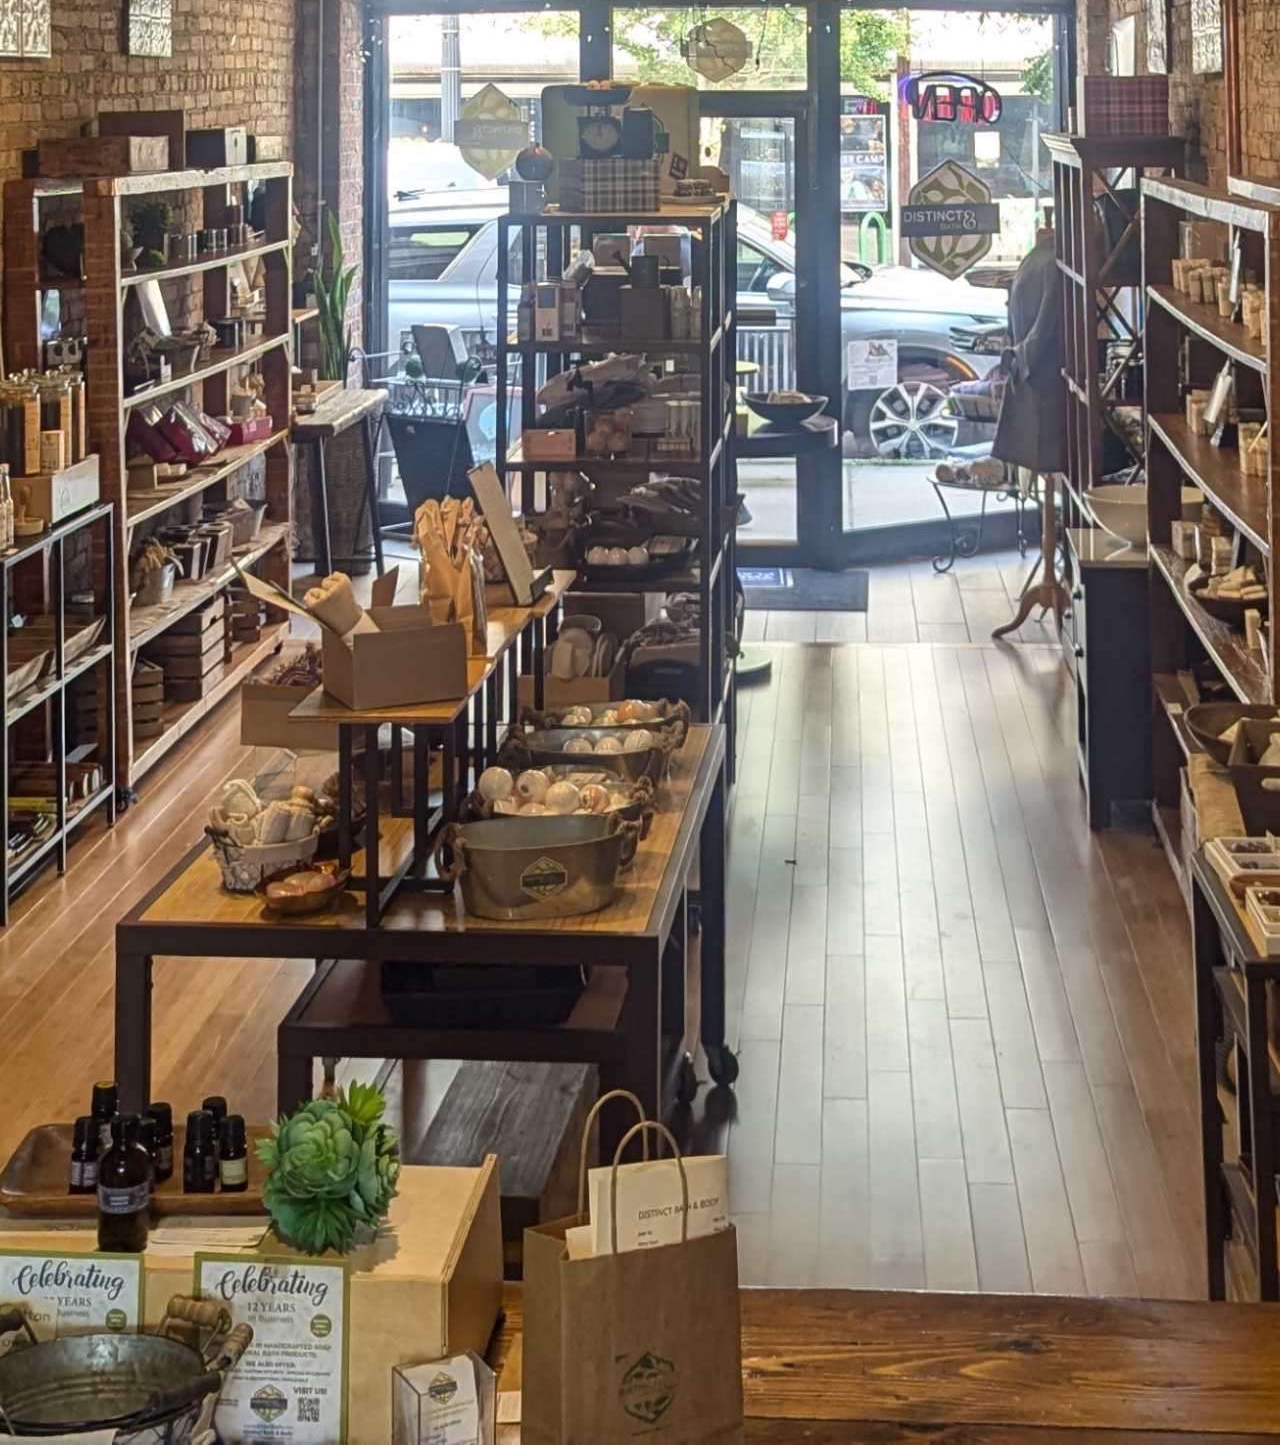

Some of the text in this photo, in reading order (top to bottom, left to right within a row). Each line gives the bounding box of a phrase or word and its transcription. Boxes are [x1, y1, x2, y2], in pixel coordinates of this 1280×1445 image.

[856, 154, 884, 164] CAMP
[903, 209, 977, 230] DISTINCT &
[11, 1259, 124, 1301] Celebrating
[215, 1265, 328, 1307] Celebrating
[57, 1296, 92, 1307] YEARS
[261, 1302, 296, 1313] YEARS
